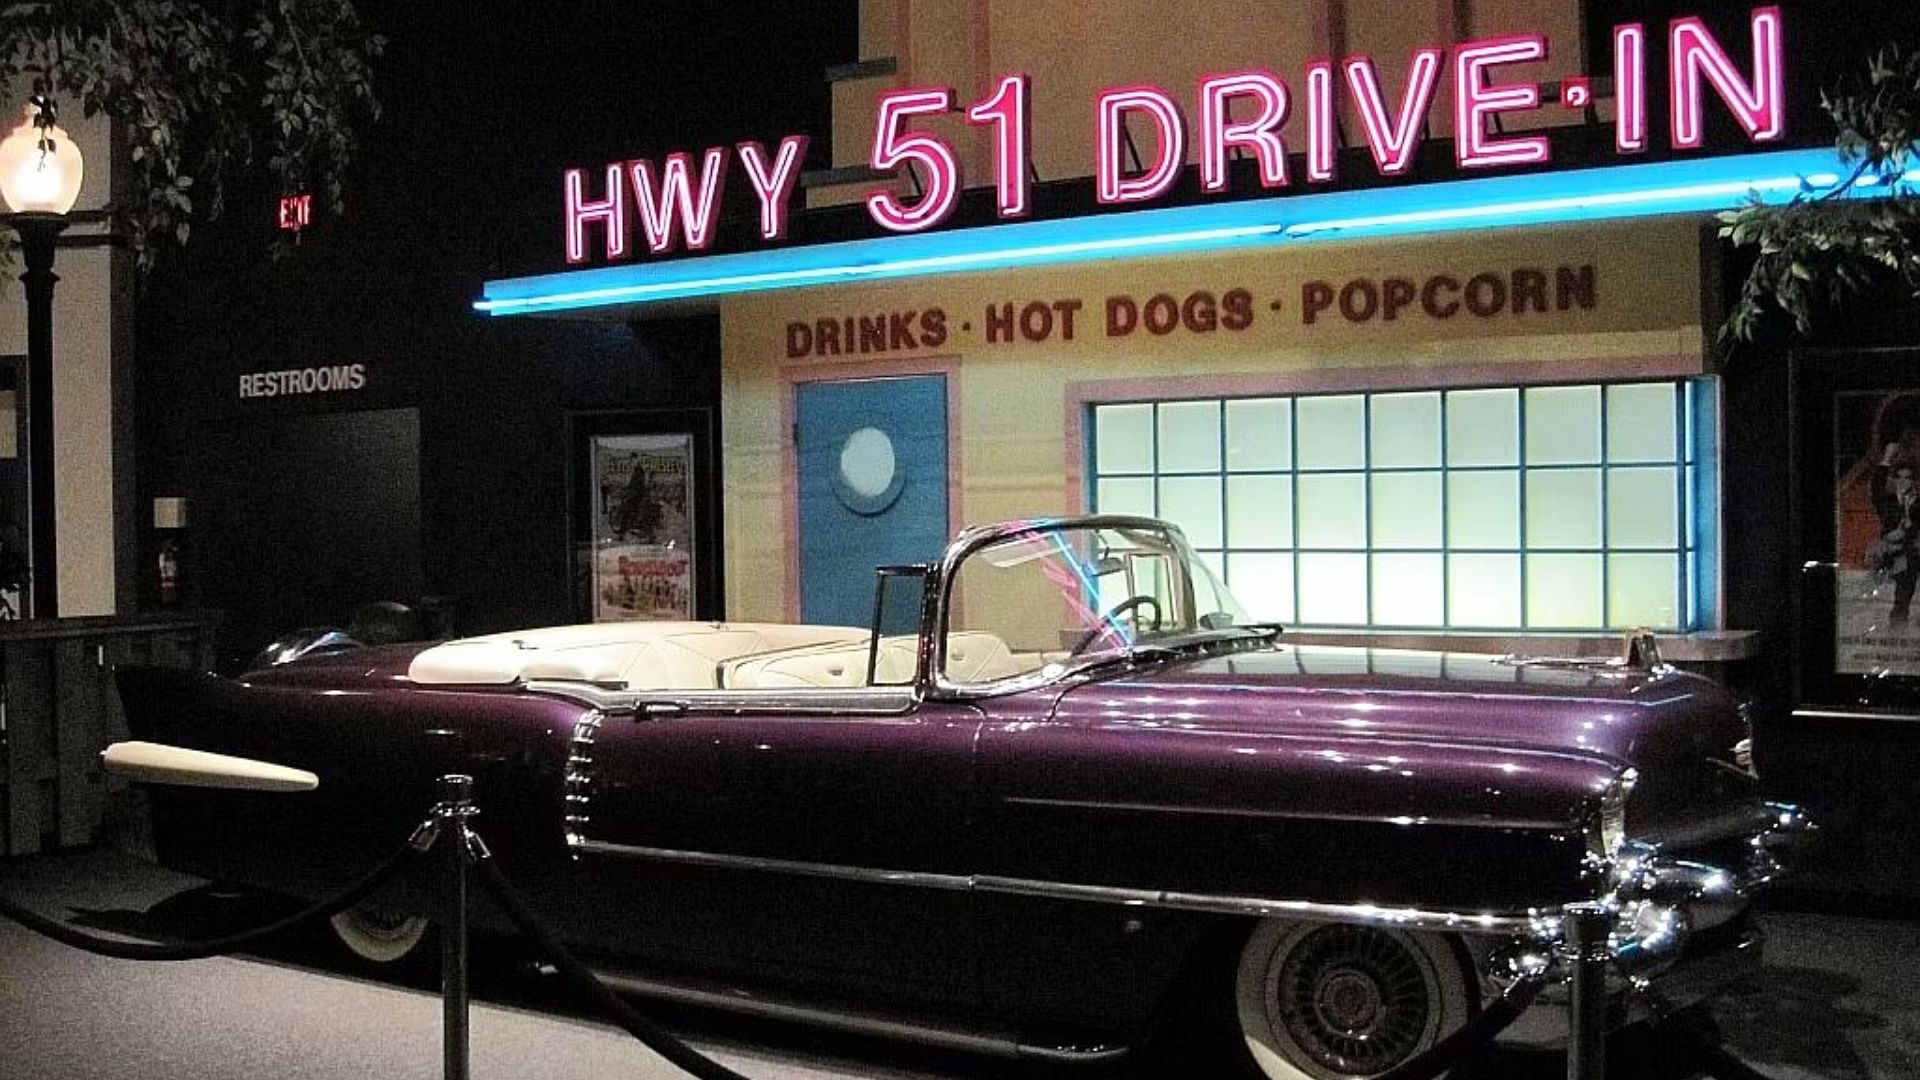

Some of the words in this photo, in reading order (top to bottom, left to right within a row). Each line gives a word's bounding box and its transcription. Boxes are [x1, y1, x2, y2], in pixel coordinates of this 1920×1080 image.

[565, 135, 807, 264] HWY
[868, 74, 1031, 232] 51
[786, 307, 946, 358] DRINKS
[986, 299, 1082, 343] HOT
[1106, 288, 1254, 337] DOGS
[1303, 266, 1598, 324] POPCORN
[240, 365, 366, 398] RESTROOMS
